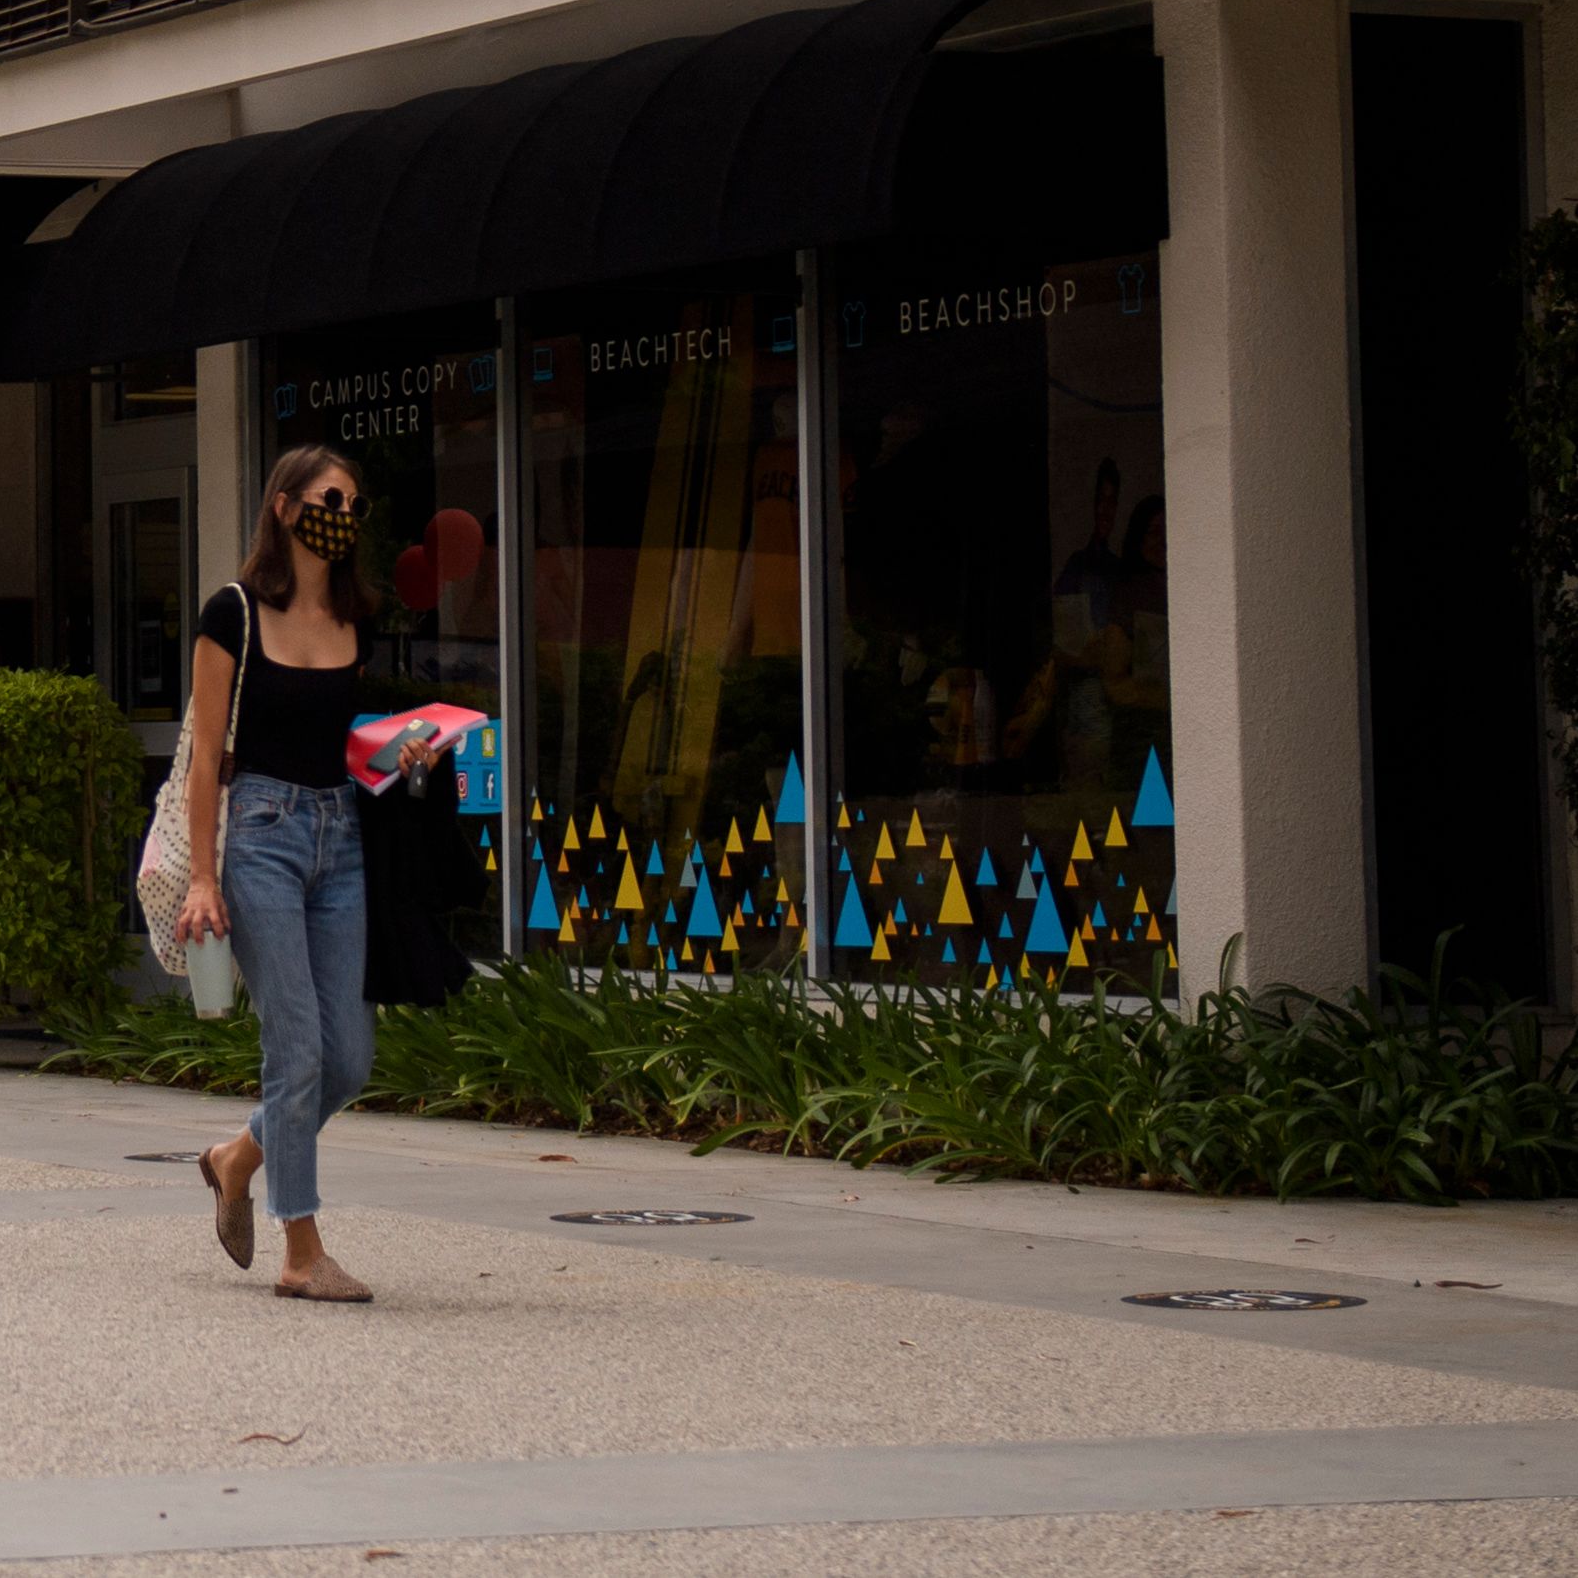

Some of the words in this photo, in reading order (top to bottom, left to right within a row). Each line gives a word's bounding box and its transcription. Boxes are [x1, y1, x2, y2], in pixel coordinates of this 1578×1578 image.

[900, 279, 1077, 335] BEACHSHOP
[590, 327, 732, 373] BEACHTECH
[309, 371, 391, 409] CAMPUS
[401, 361, 457, 397] COPY
[341, 404, 419, 442] CENTER
